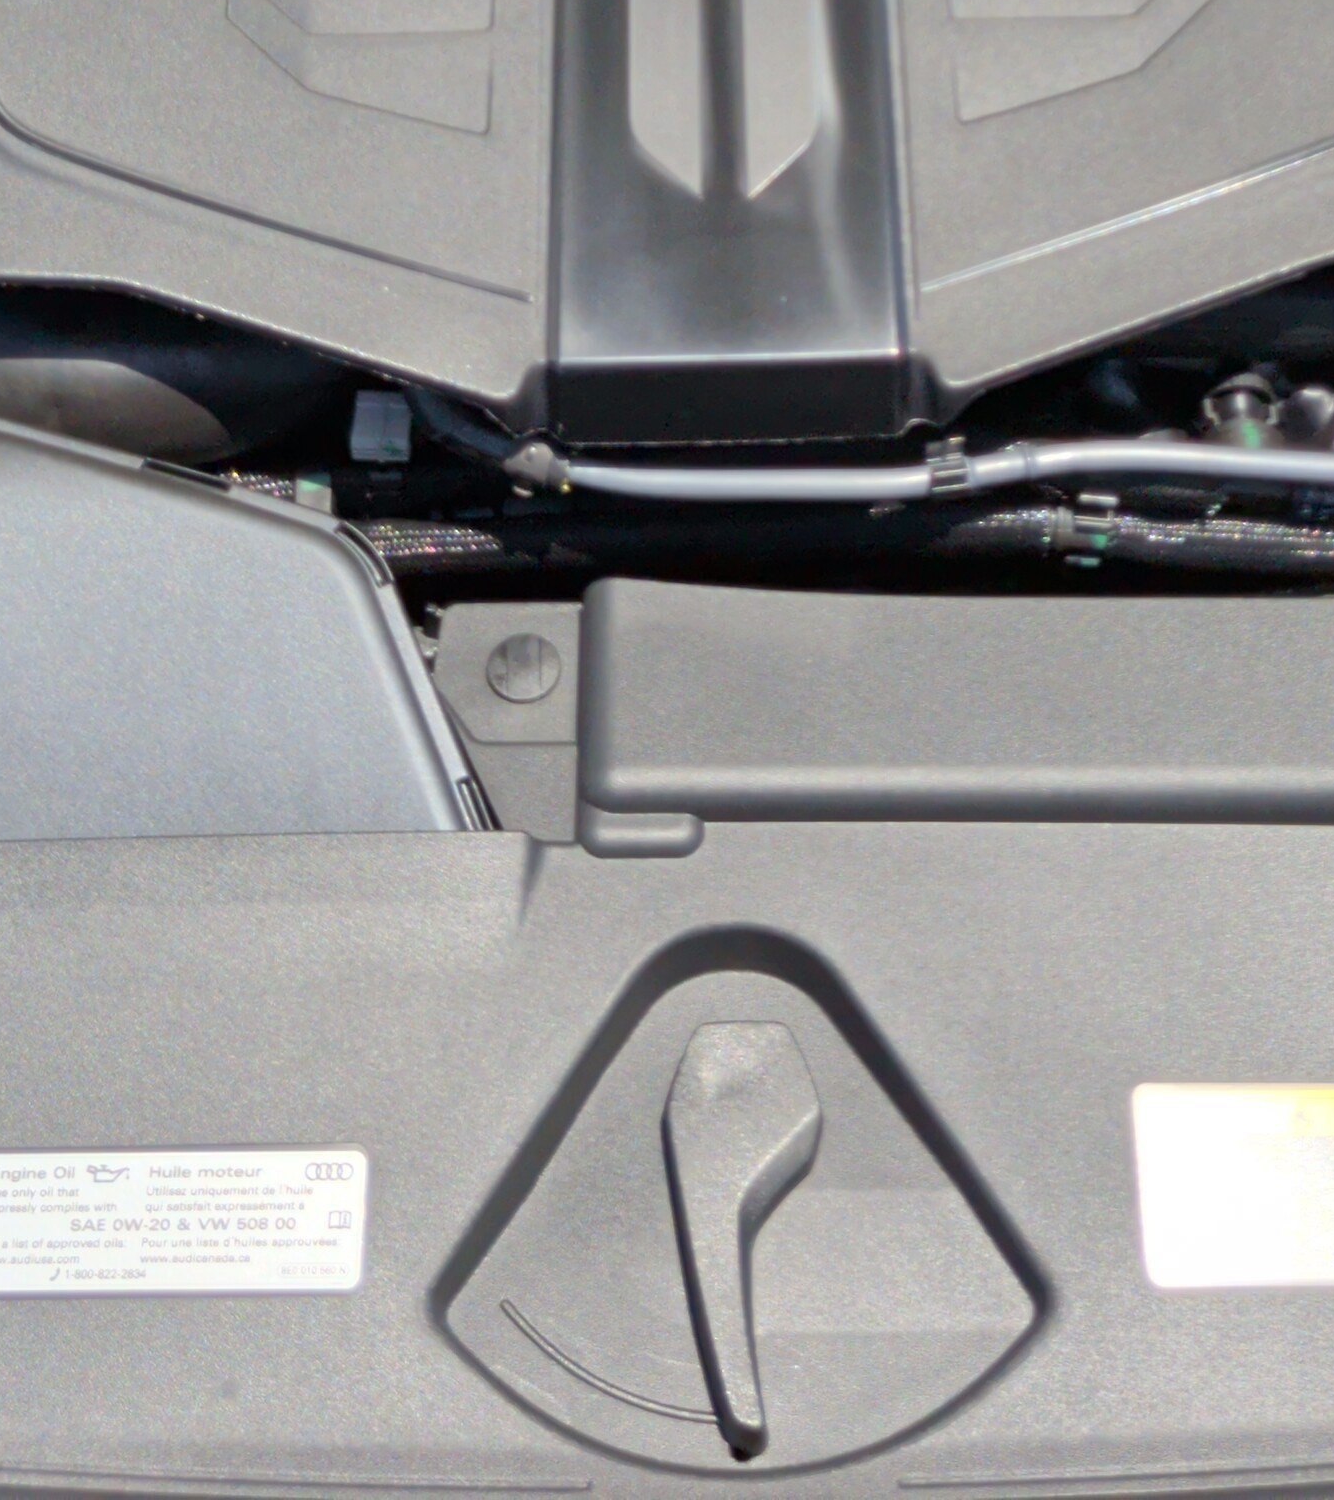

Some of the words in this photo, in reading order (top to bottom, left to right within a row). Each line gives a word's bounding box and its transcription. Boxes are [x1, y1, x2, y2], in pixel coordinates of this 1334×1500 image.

[53, 1166, 75, 1180] Oil
[149, 1166, 192, 1178] Huile
[197, 1165, 263, 1179] moteur
[11, 1186, 36, 1199] only
[39, 1186, 54, 1197] oil
[57, 1186, 80, 1197] that
[146, 1185, 187, 1197] Utilisez
[190, 1185, 259, 1198] uniquement
[262, 1185, 276, 1196] de
[40, 1201, 91, 1214] complies
[94, 1201, 118, 1213] with
[145, 1202, 163, 1213] qui
[166, 1201, 211, 1212] satisfait
[214, 1200, 295, 1213] expressément
[70, 1218, 106, 1232] SAE
[113, 1218, 172, 1232] 0W-20
[176, 1218, 191, 1231] &
[198, 1218, 231, 1231] VW
[237, 1217, 269, 1230] 508
[275, 1217, 297, 1230] 00
[1, 1239, 8, 1249] a
[11, 1238, 28, 1249] list
[31, 1238, 44, 1249] of
[46, 1237, 101, 1251] approved
[141, 1236, 167, 1248] Pour
[171, 1238, 193, 1248] une
[196, 1236, 219, 1248] liste
[223, 1235, 269, 1248] d'huiles
[139, 1252, 251, 1264] www.audicanada.ca
[65, 1268, 147, 1281] 1-800-822-2834
